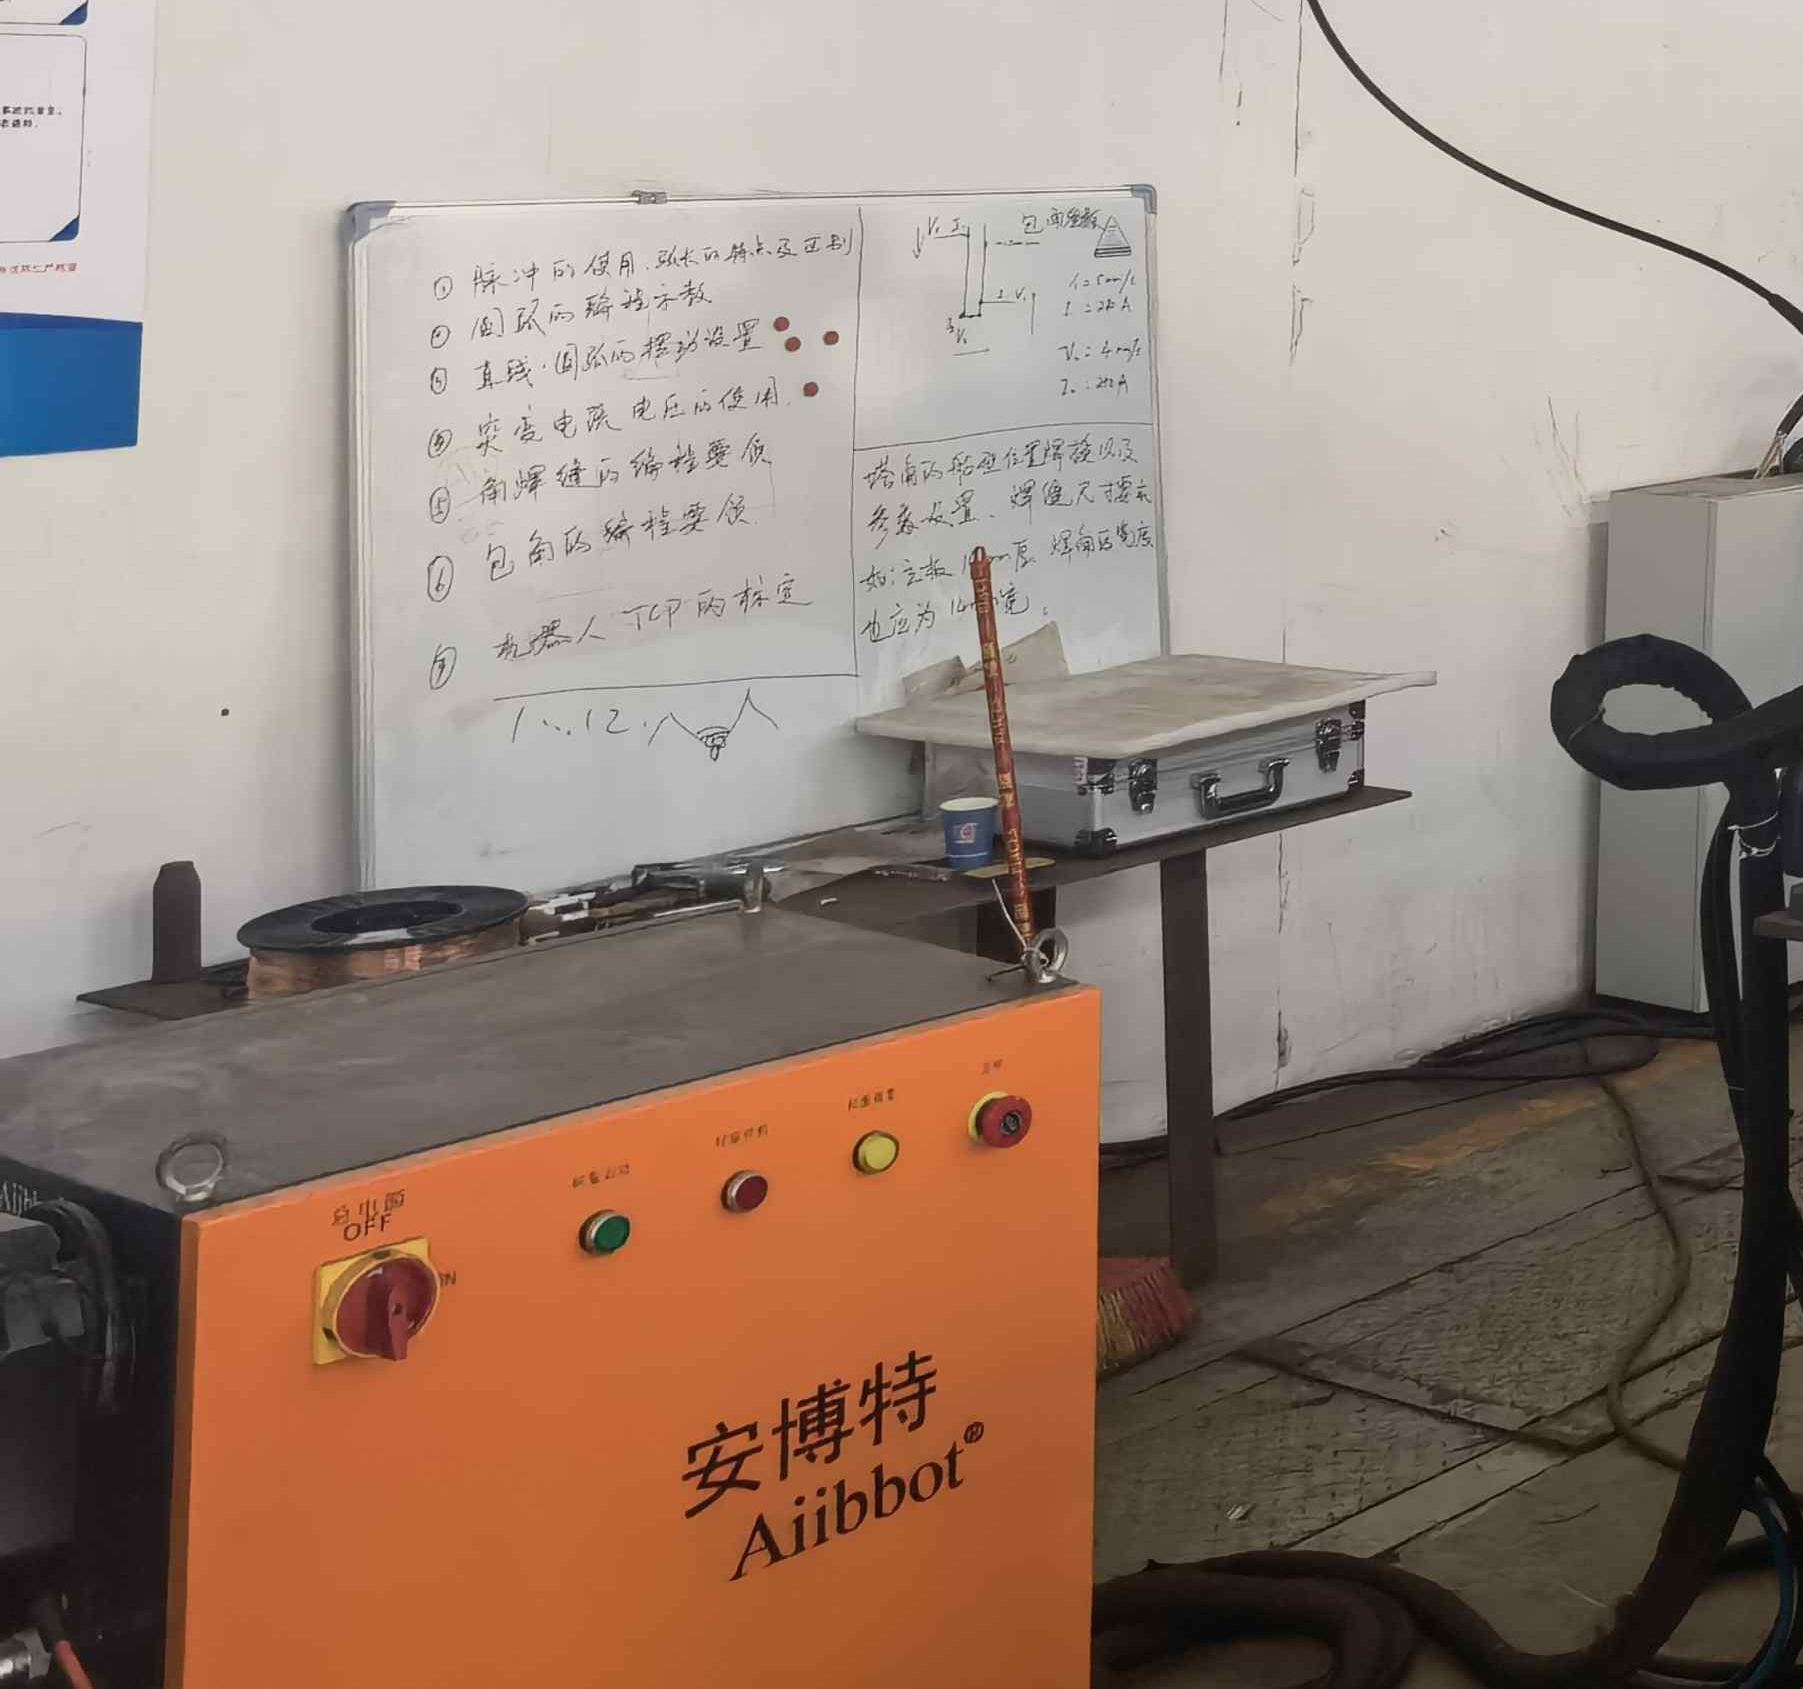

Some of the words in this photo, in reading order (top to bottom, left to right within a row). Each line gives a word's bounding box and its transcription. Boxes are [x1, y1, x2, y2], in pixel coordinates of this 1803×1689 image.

[343, 1213, 392, 1242] OFF
[681, 1350, 937, 1519] 安博特
